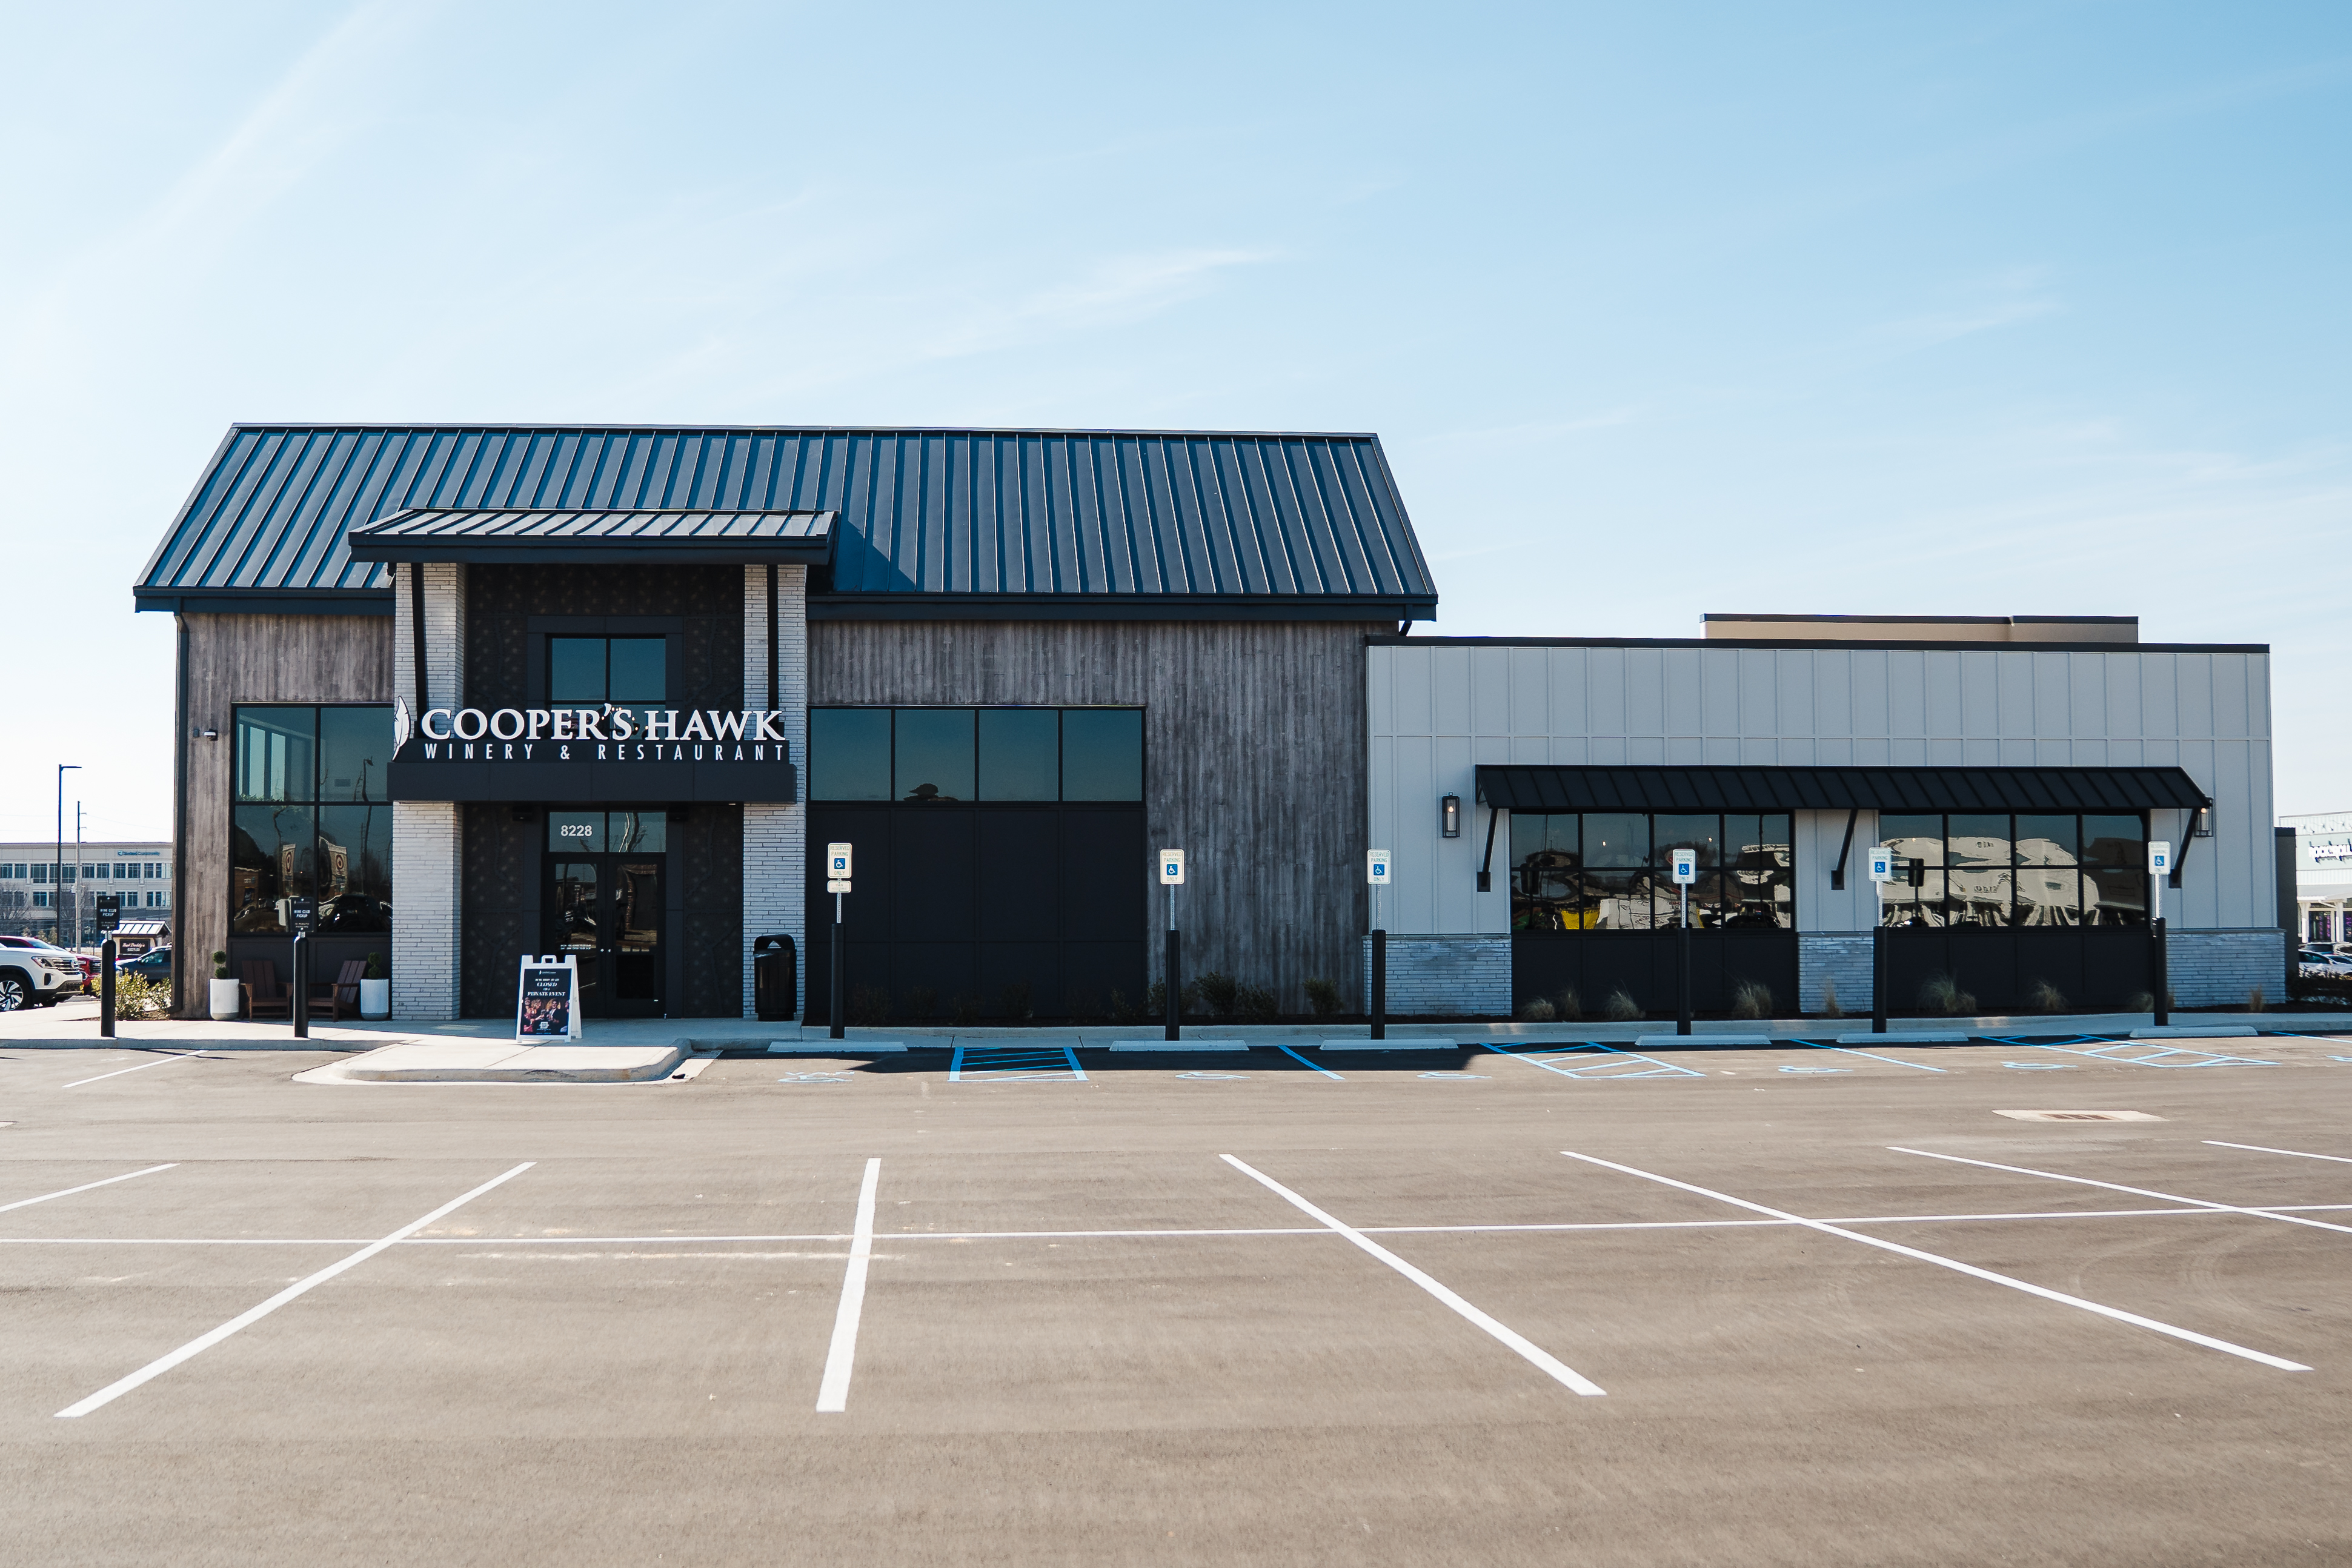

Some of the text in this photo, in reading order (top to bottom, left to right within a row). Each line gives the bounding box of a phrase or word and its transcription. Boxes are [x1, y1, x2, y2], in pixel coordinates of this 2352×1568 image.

[421, 703, 786, 741] COOPER'S HAWK
[425, 743, 783, 760] WINERY & RESTAURANT
[560, 825, 593, 837] 8228
